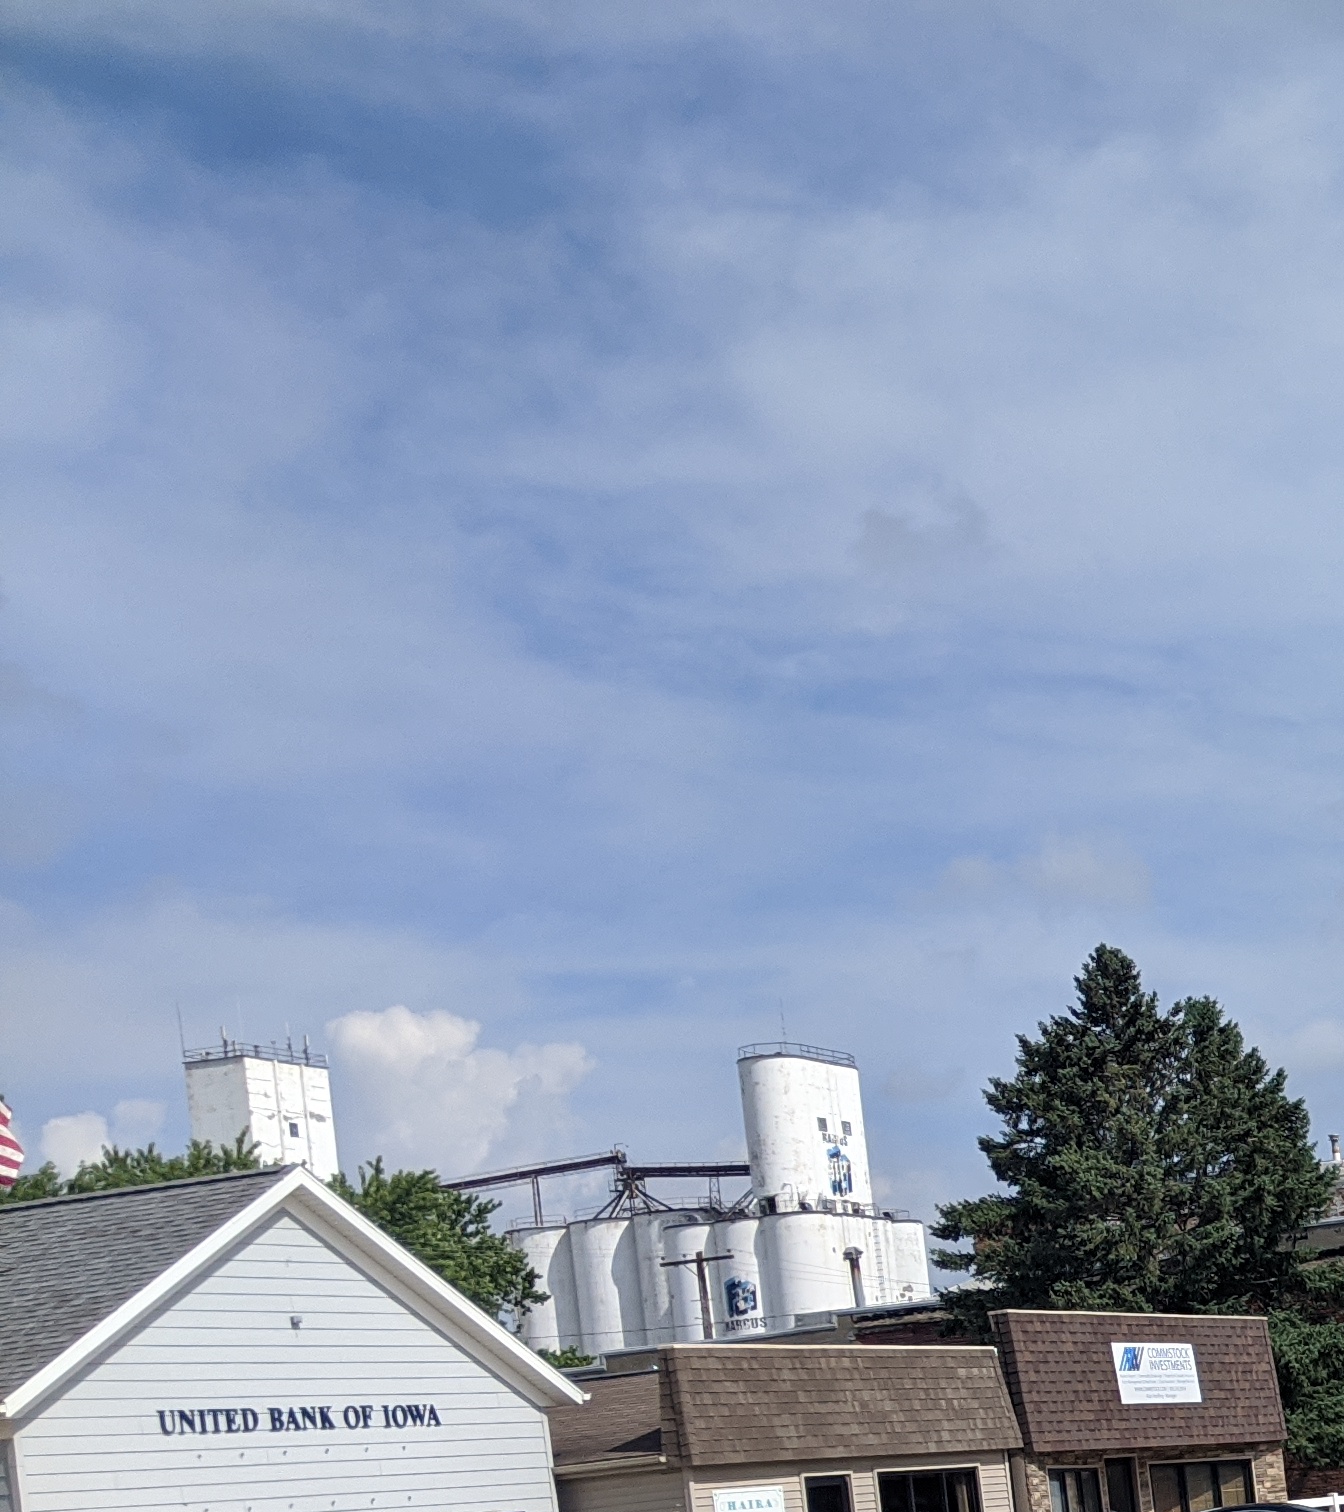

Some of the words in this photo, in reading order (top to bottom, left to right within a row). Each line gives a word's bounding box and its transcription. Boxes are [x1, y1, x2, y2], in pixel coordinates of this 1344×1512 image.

[156, 1407, 260, 1436] UNITED
[267, 1405, 336, 1432] BANK
[343, 1404, 374, 1430] OF
[381, 1403, 442, 1429] IOWA
